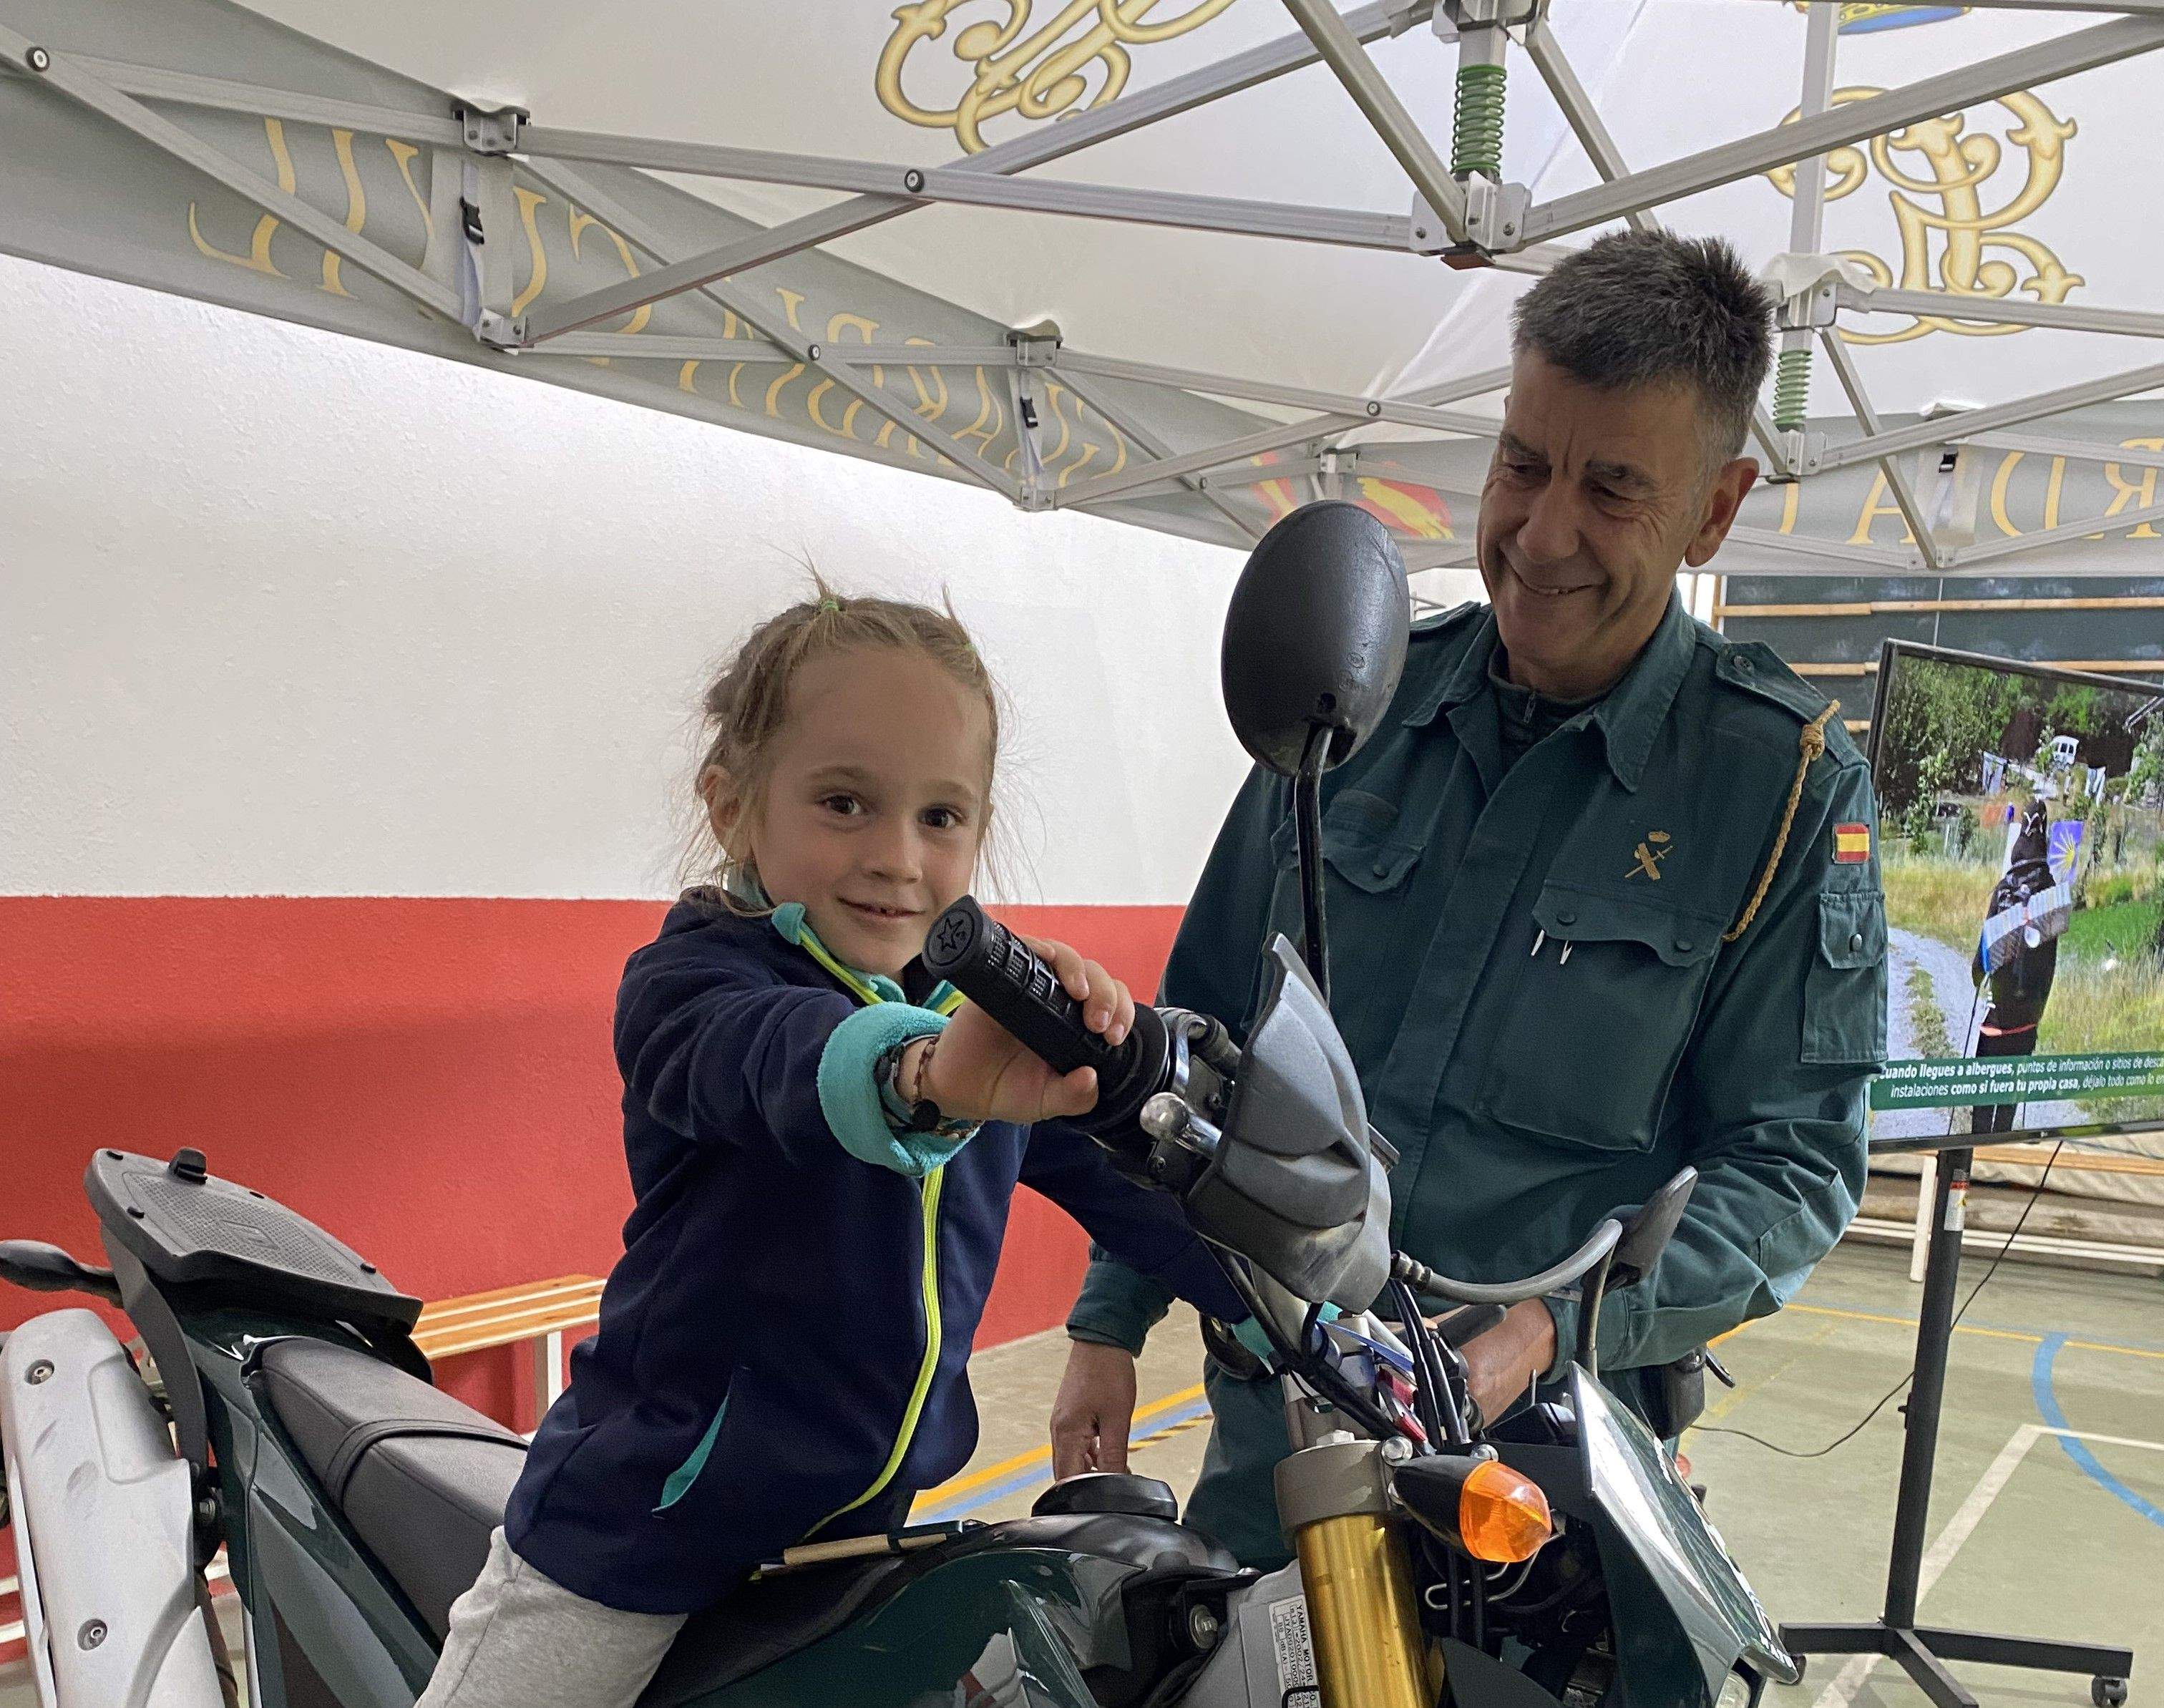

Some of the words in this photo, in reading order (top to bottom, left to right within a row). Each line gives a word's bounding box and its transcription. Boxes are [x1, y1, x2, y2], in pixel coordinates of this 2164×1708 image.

[1879, 1064, 1917, 1079] uando
[1919, 1063, 1956, 1080] llegues
[1957, 1065, 1964, 1076] a
[1966, 1063, 2014, 1078] albergues,
[2017, 1060, 2044, 1075] puntos
[2047, 1060, 2057, 1072] de
[2059, 1057, 2103, 1072] información
[2133, 1056, 2143, 1068] de
[1891, 1083, 1948, 1098] instalaciones
[1951, 1083, 1977, 1095] como
[1979, 1080, 1988, 1094] si
[1990, 1079, 2014, 1093] fuera
[2017, 1079, 2027, 1091] tu
[2028, 1077, 2057, 1094] propia
[2059, 1078, 2080, 1090] casa,
[2082, 1075, 2105, 1091] déjalo
[2107, 1075, 2125, 1087] todo
[2126, 1075, 2145, 1085] como
[1296, 1604, 1307, 1643] YAMAHA
[1303, 1650, 1313, 1682] MOTOR
